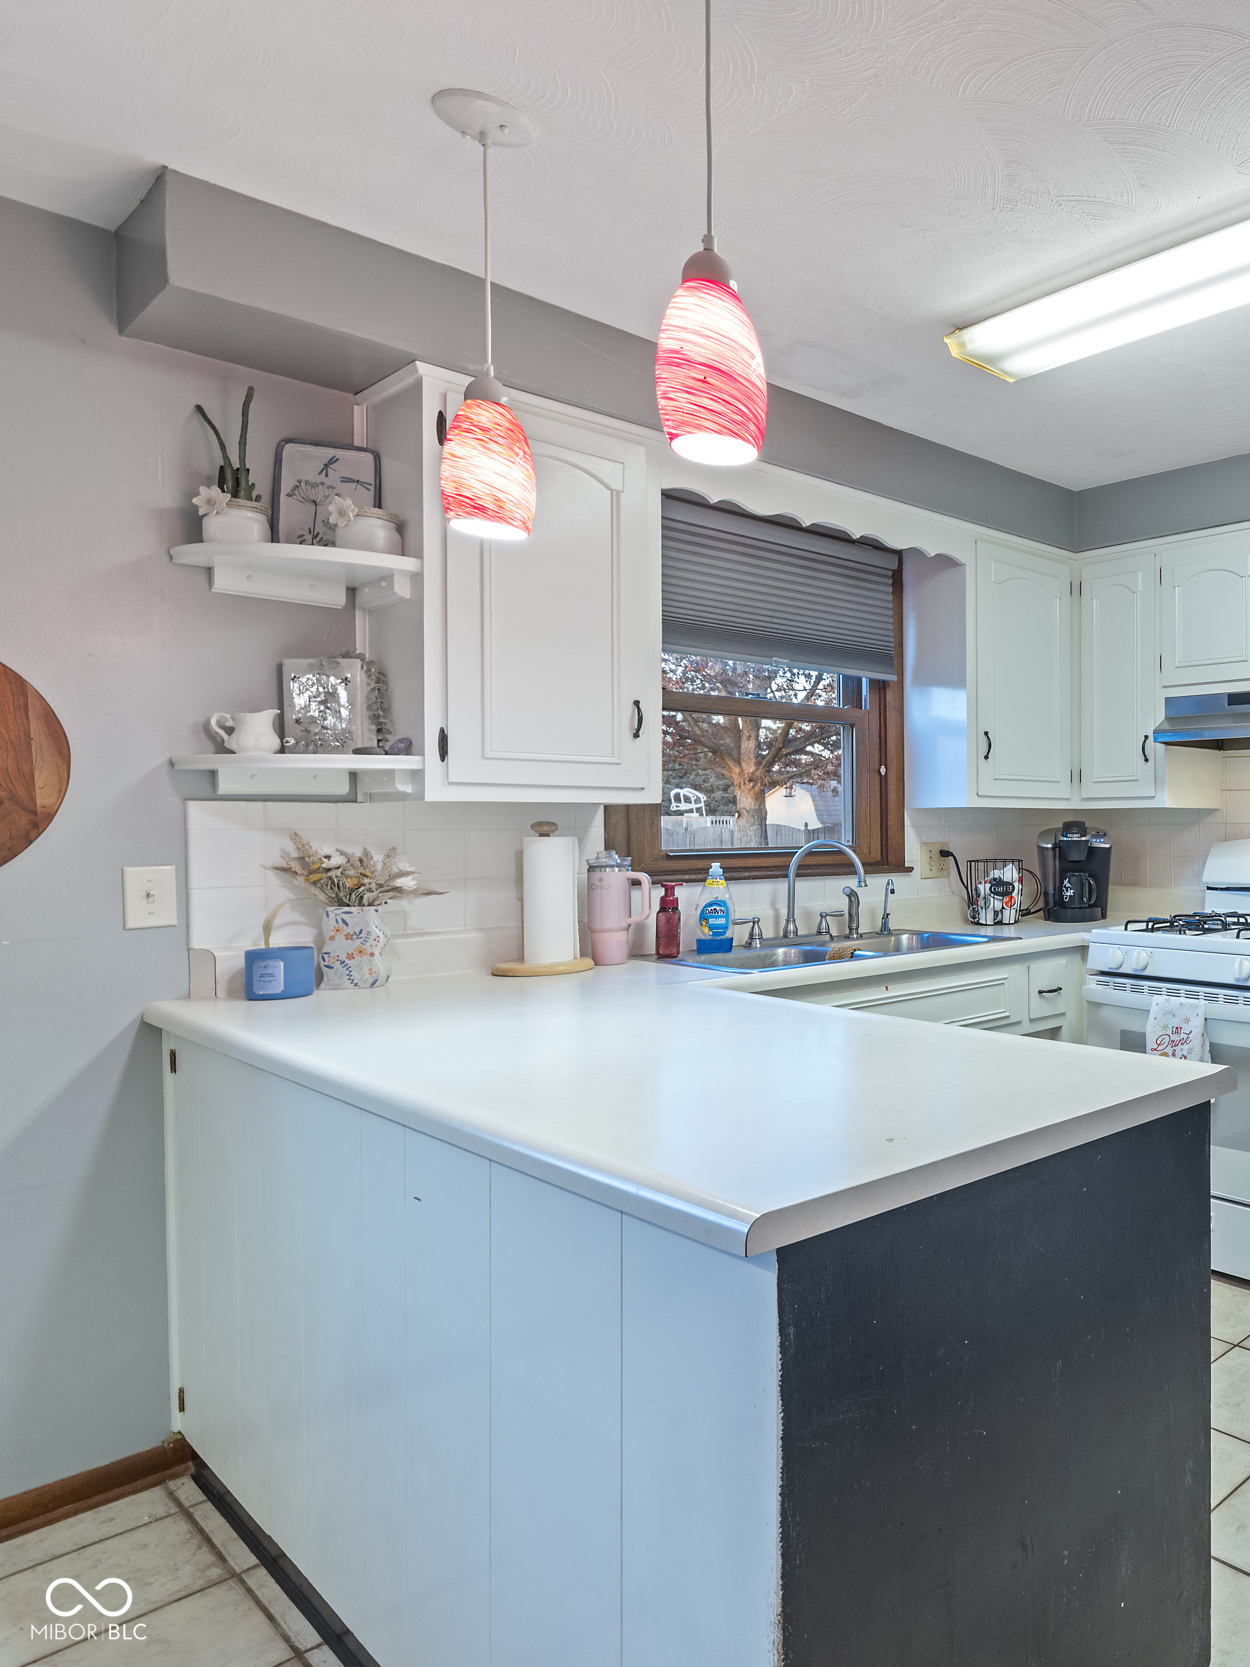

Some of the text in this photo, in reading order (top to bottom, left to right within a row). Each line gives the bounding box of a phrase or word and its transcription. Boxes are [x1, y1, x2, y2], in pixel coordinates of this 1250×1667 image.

[991, 885, 1013, 893] COFFEE
[704, 907, 726, 916] DAWN
[1171, 1026, 1183, 1035] EAT
[1150, 1030, 1193, 1052] Drink
